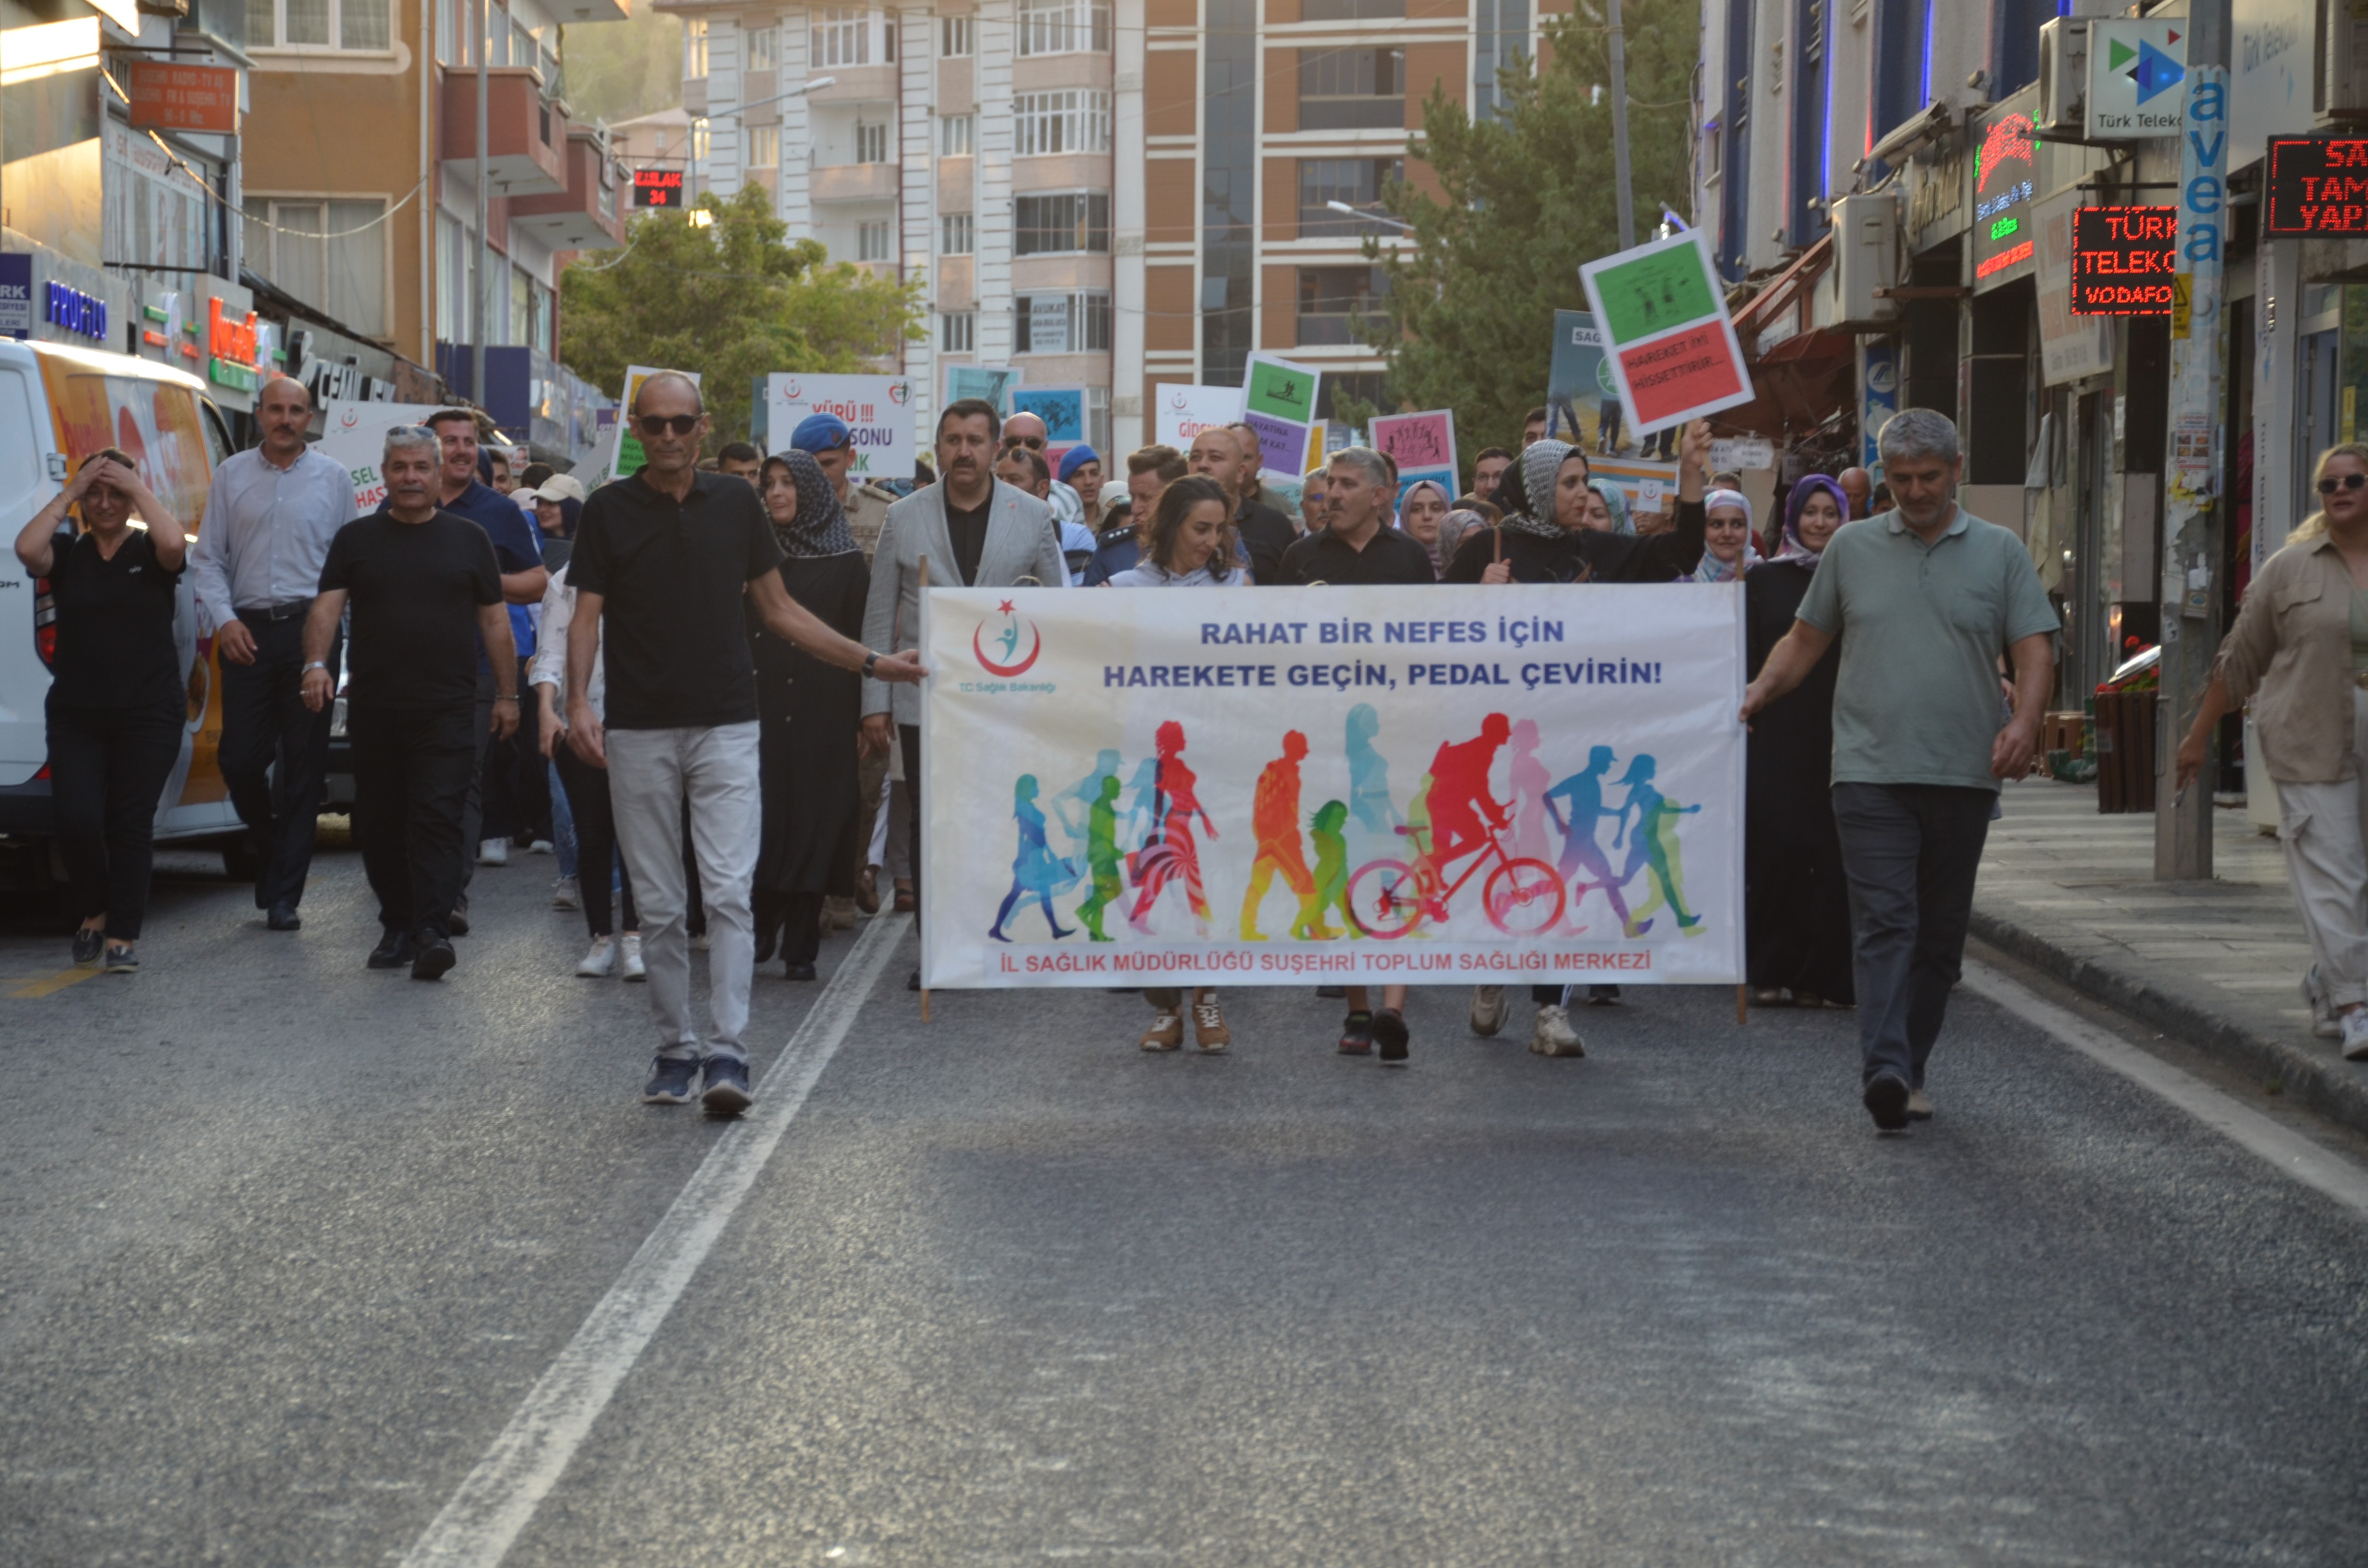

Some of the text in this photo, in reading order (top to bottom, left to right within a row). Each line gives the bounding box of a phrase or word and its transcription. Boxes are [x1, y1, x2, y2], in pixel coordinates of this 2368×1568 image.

[2098, 113, 2182, 128] Türk Telek
[2185, 82, 2225, 262] avea
[2106, 211, 2179, 240] TÜRK
[2080, 250, 2177, 274] TELEKO
[0, 285, 26, 299] RK
[2085, 286, 2172, 304] VODAFO
[1628, 342, 1688, 369] HAREKET
[354, 485, 386, 509] HAS
[1201, 615, 1564, 649] RAHAT BİR NEFES İÇİN
[1104, 657, 1662, 692] HAREKETE GEÇİN, PEDAL ÇEVİRİN!
[1000, 949, 1652, 975] İL SAĞLIK MÜDÜRLÜĞÜ SUŞEHRİ TOPLUM SAĞLIĞI MERKEZİ
